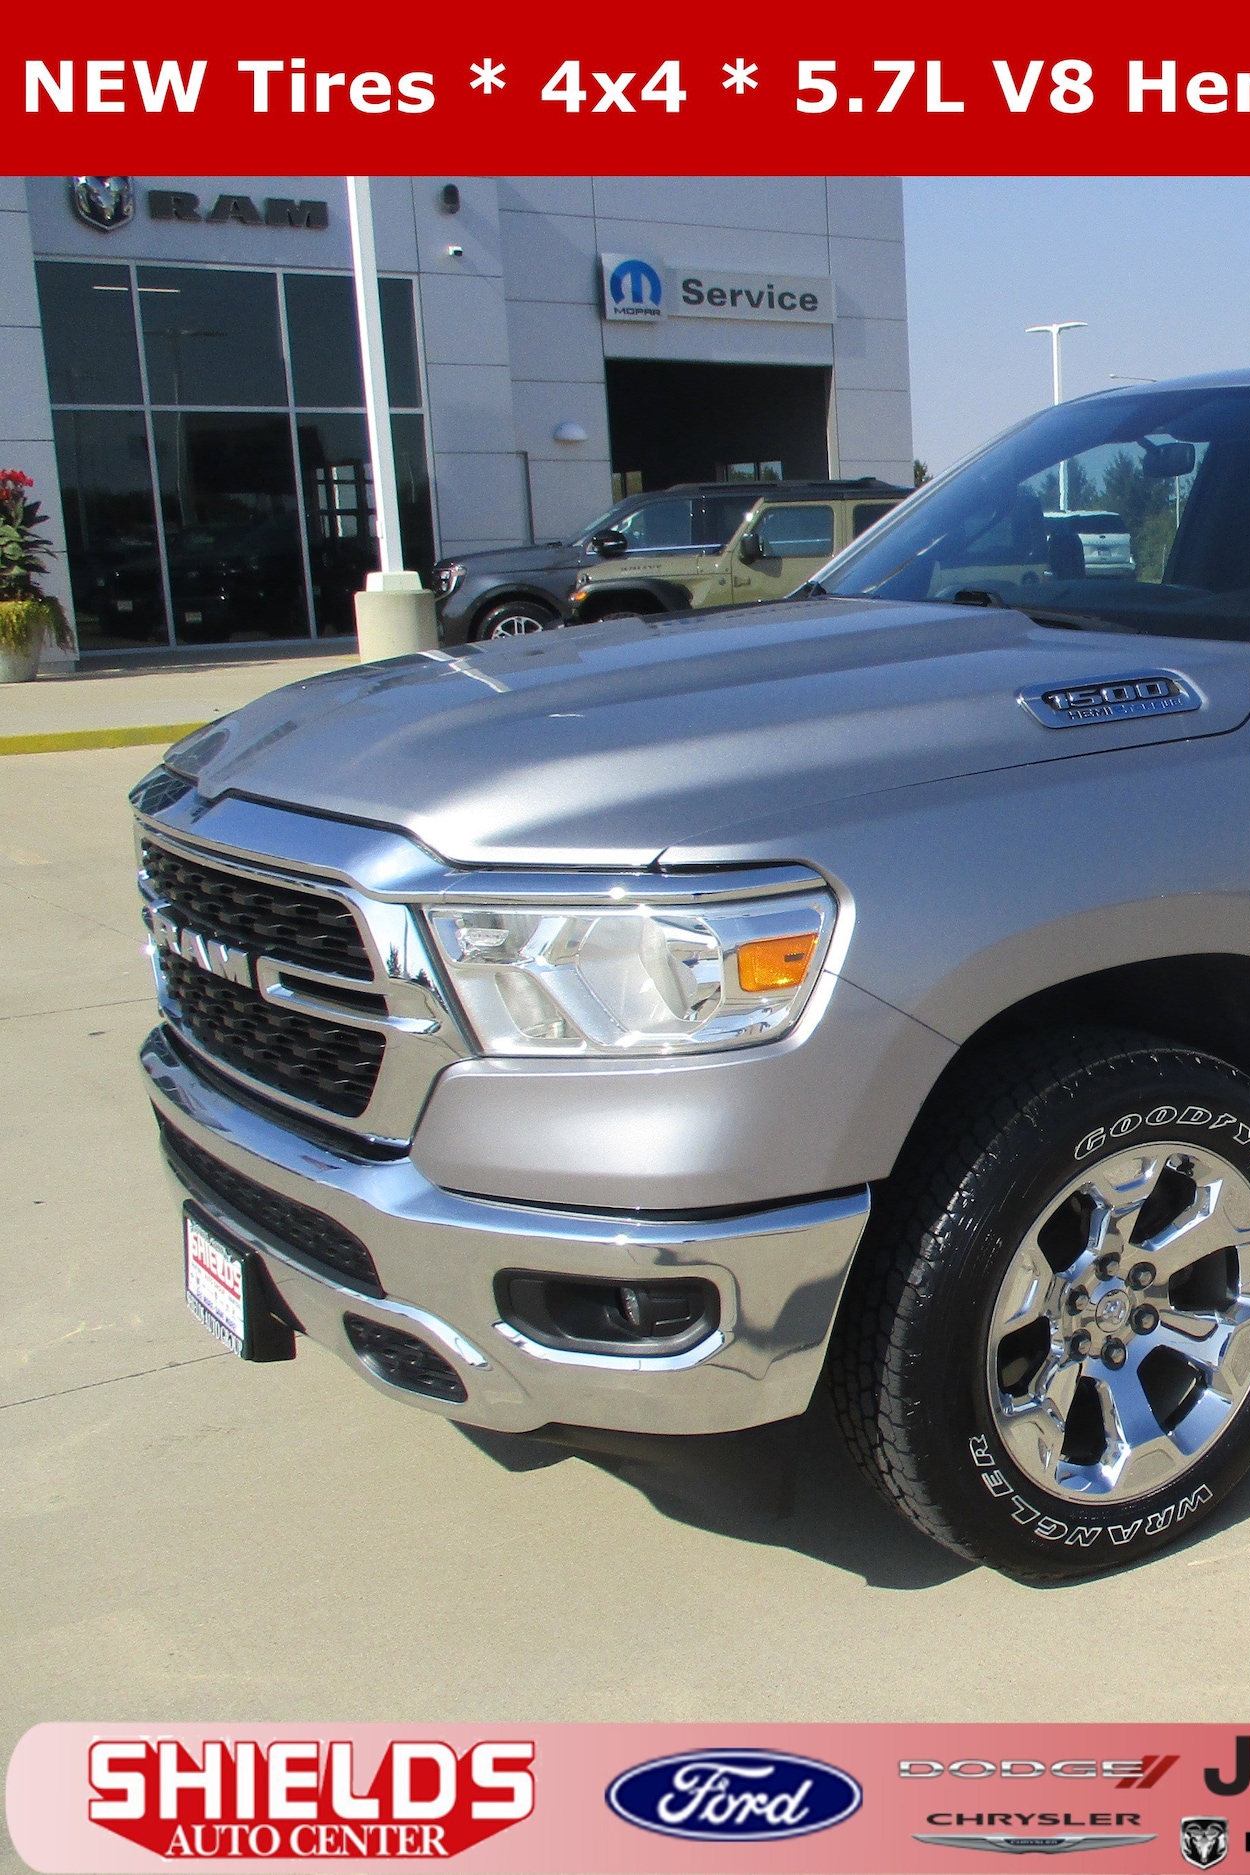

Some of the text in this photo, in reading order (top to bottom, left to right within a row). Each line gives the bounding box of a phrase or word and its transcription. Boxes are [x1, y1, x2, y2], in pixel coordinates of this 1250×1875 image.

[148, 190, 328, 229] RAM
[614, 306, 662, 317] MOPAR
[682, 278, 819, 312] Service
[1048, 681, 1170, 711] 1500
[150, 909, 253, 989] RAM
[191, 1233, 242, 1297] SHIELDS
[968, 1433, 1214, 1548] WRANGLER
